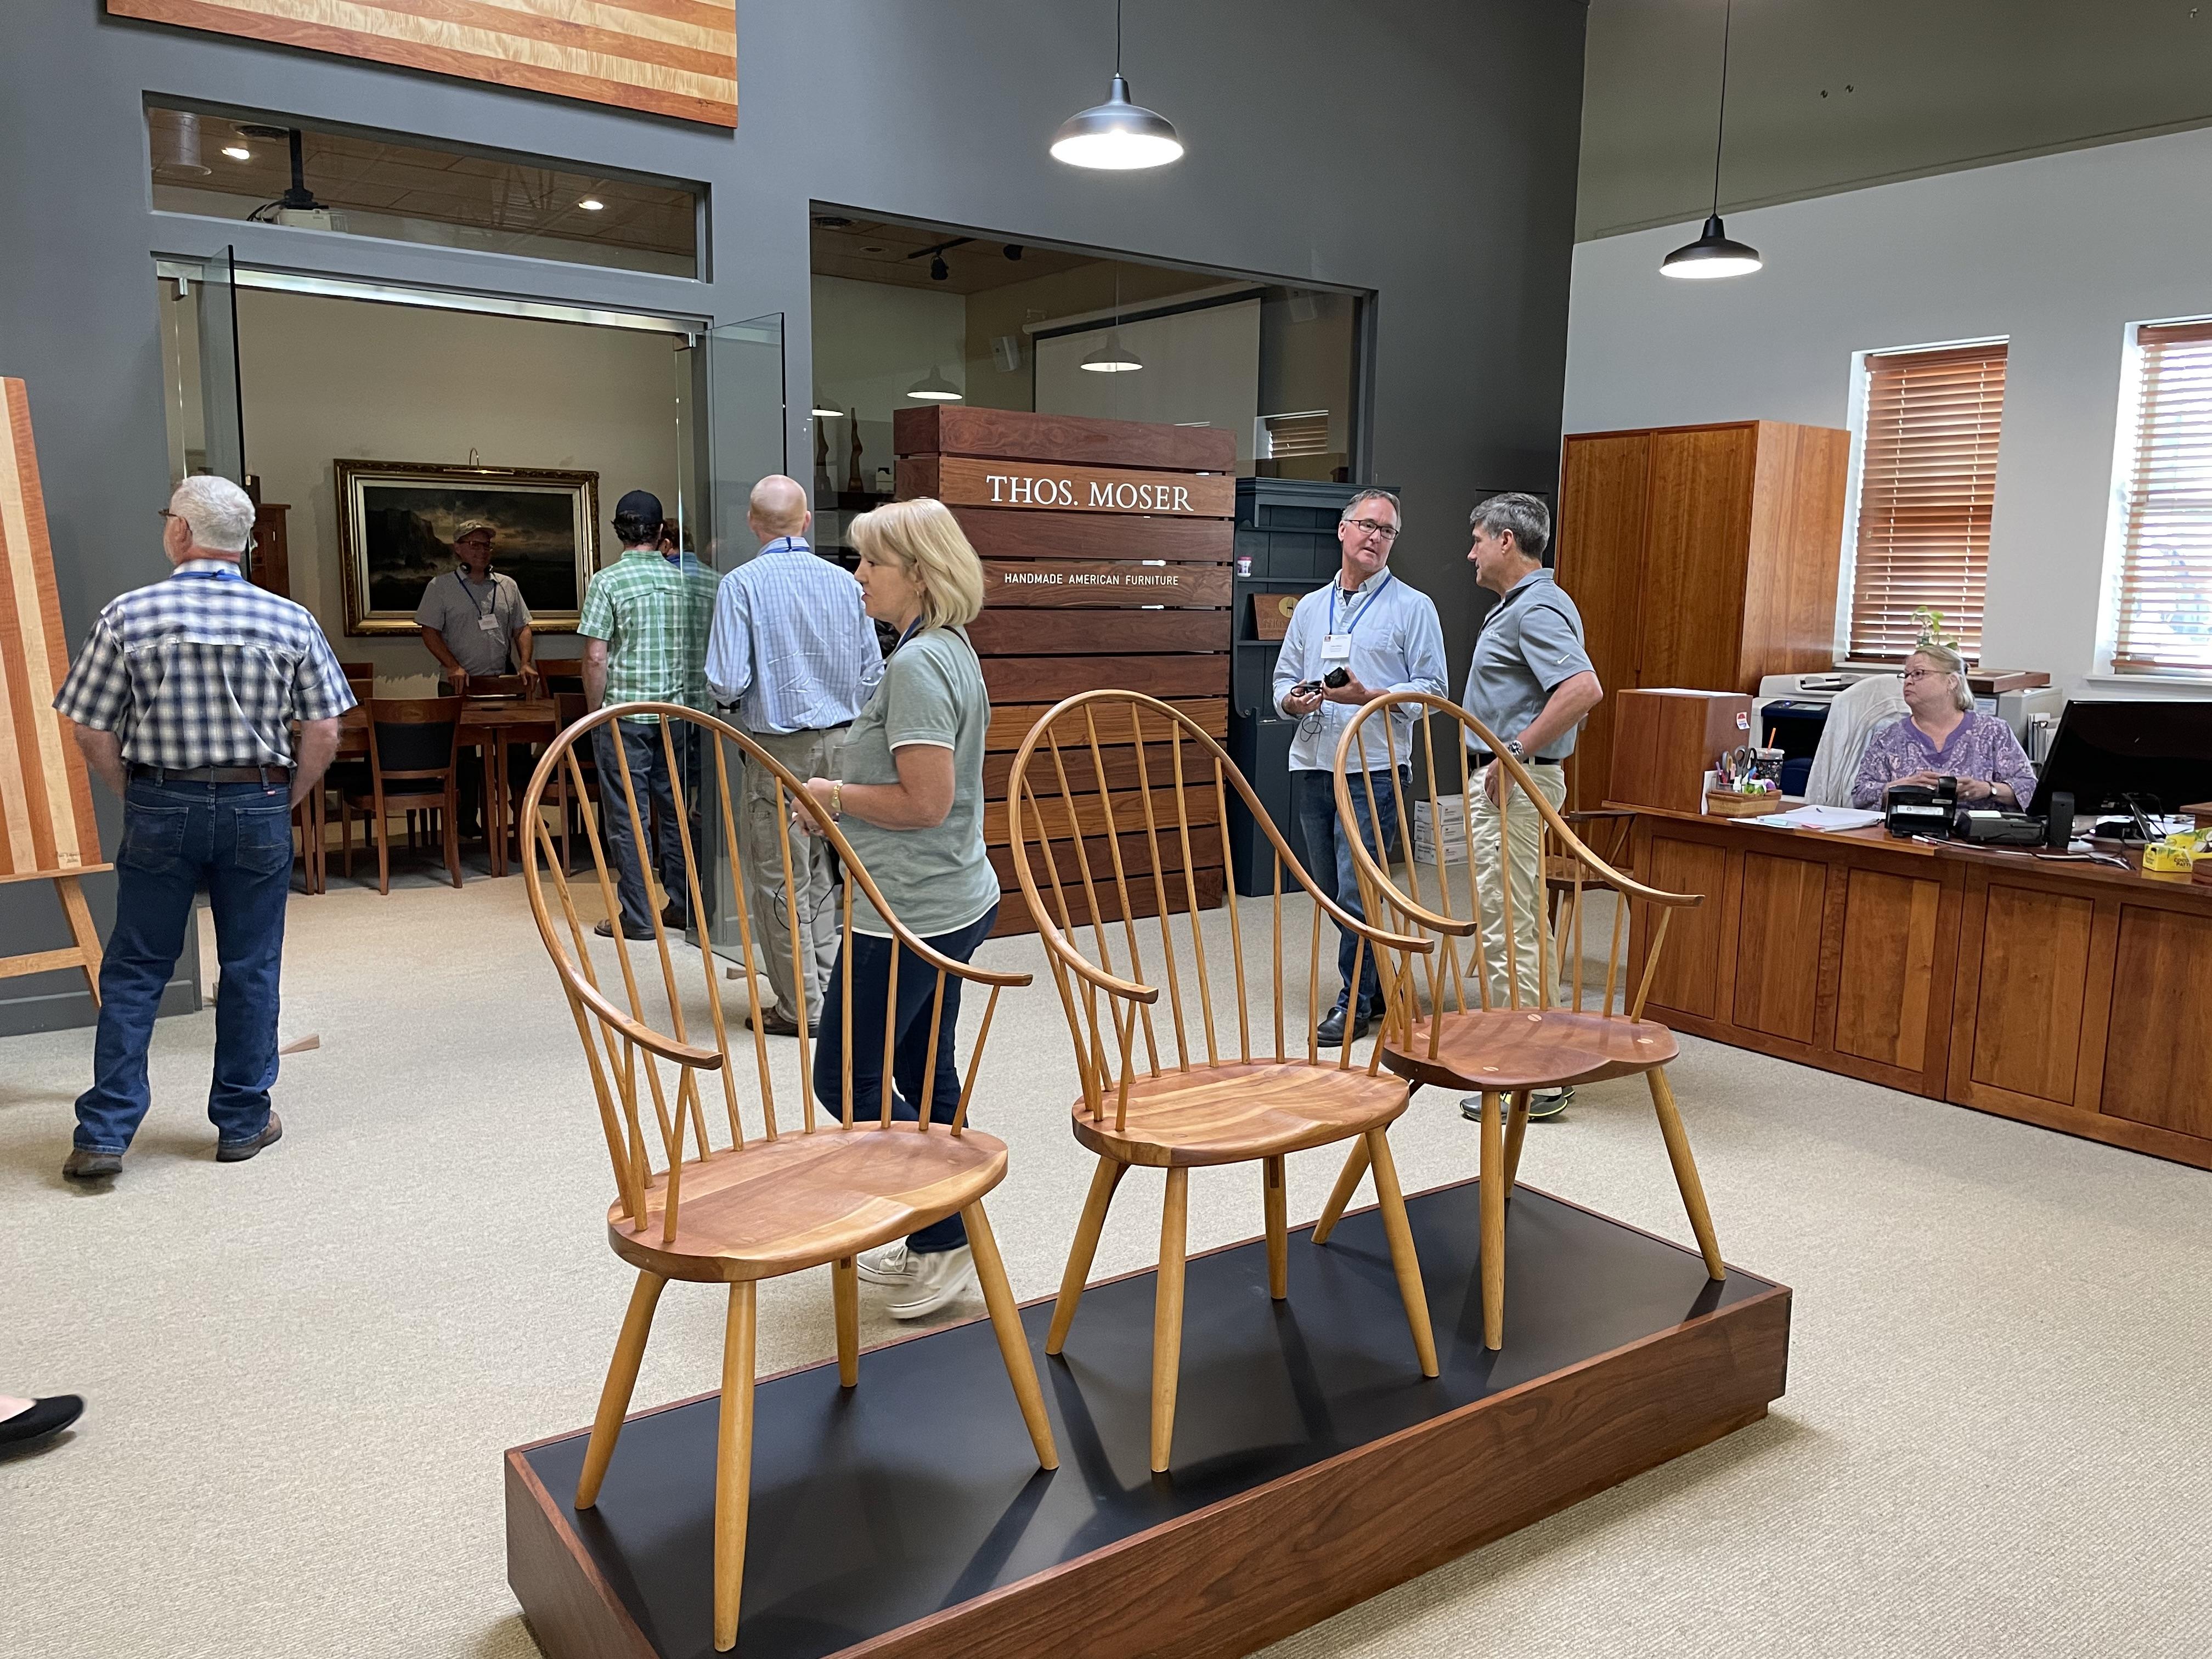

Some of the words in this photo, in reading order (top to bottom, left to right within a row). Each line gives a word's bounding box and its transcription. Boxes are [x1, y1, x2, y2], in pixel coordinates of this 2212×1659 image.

[986, 475, 1078, 506] THOS.
[1088, 481, 1194, 511] MOSER
[1005, 573, 1063, 584] HANDMADE
[1069, 574, 1120, 585] AMERICAN
[1125, 575, 1178, 585] FURNITURE
